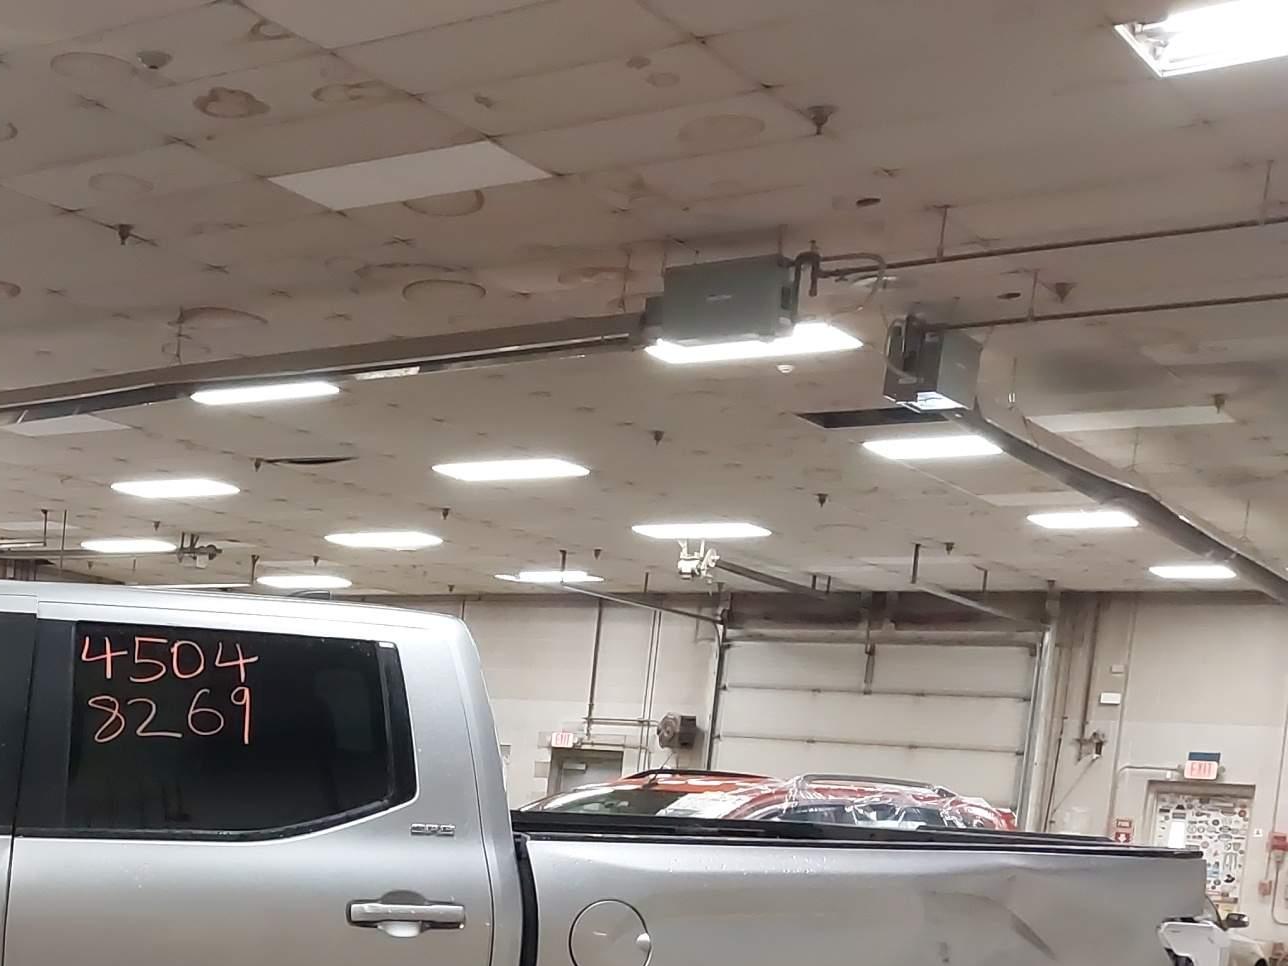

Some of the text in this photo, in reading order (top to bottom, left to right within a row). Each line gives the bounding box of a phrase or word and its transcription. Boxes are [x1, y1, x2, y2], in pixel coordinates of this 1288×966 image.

[81, 636, 259, 683] 4504
[88, 686, 250, 744] 8269
[1191, 761, 1212, 777] EXIT
